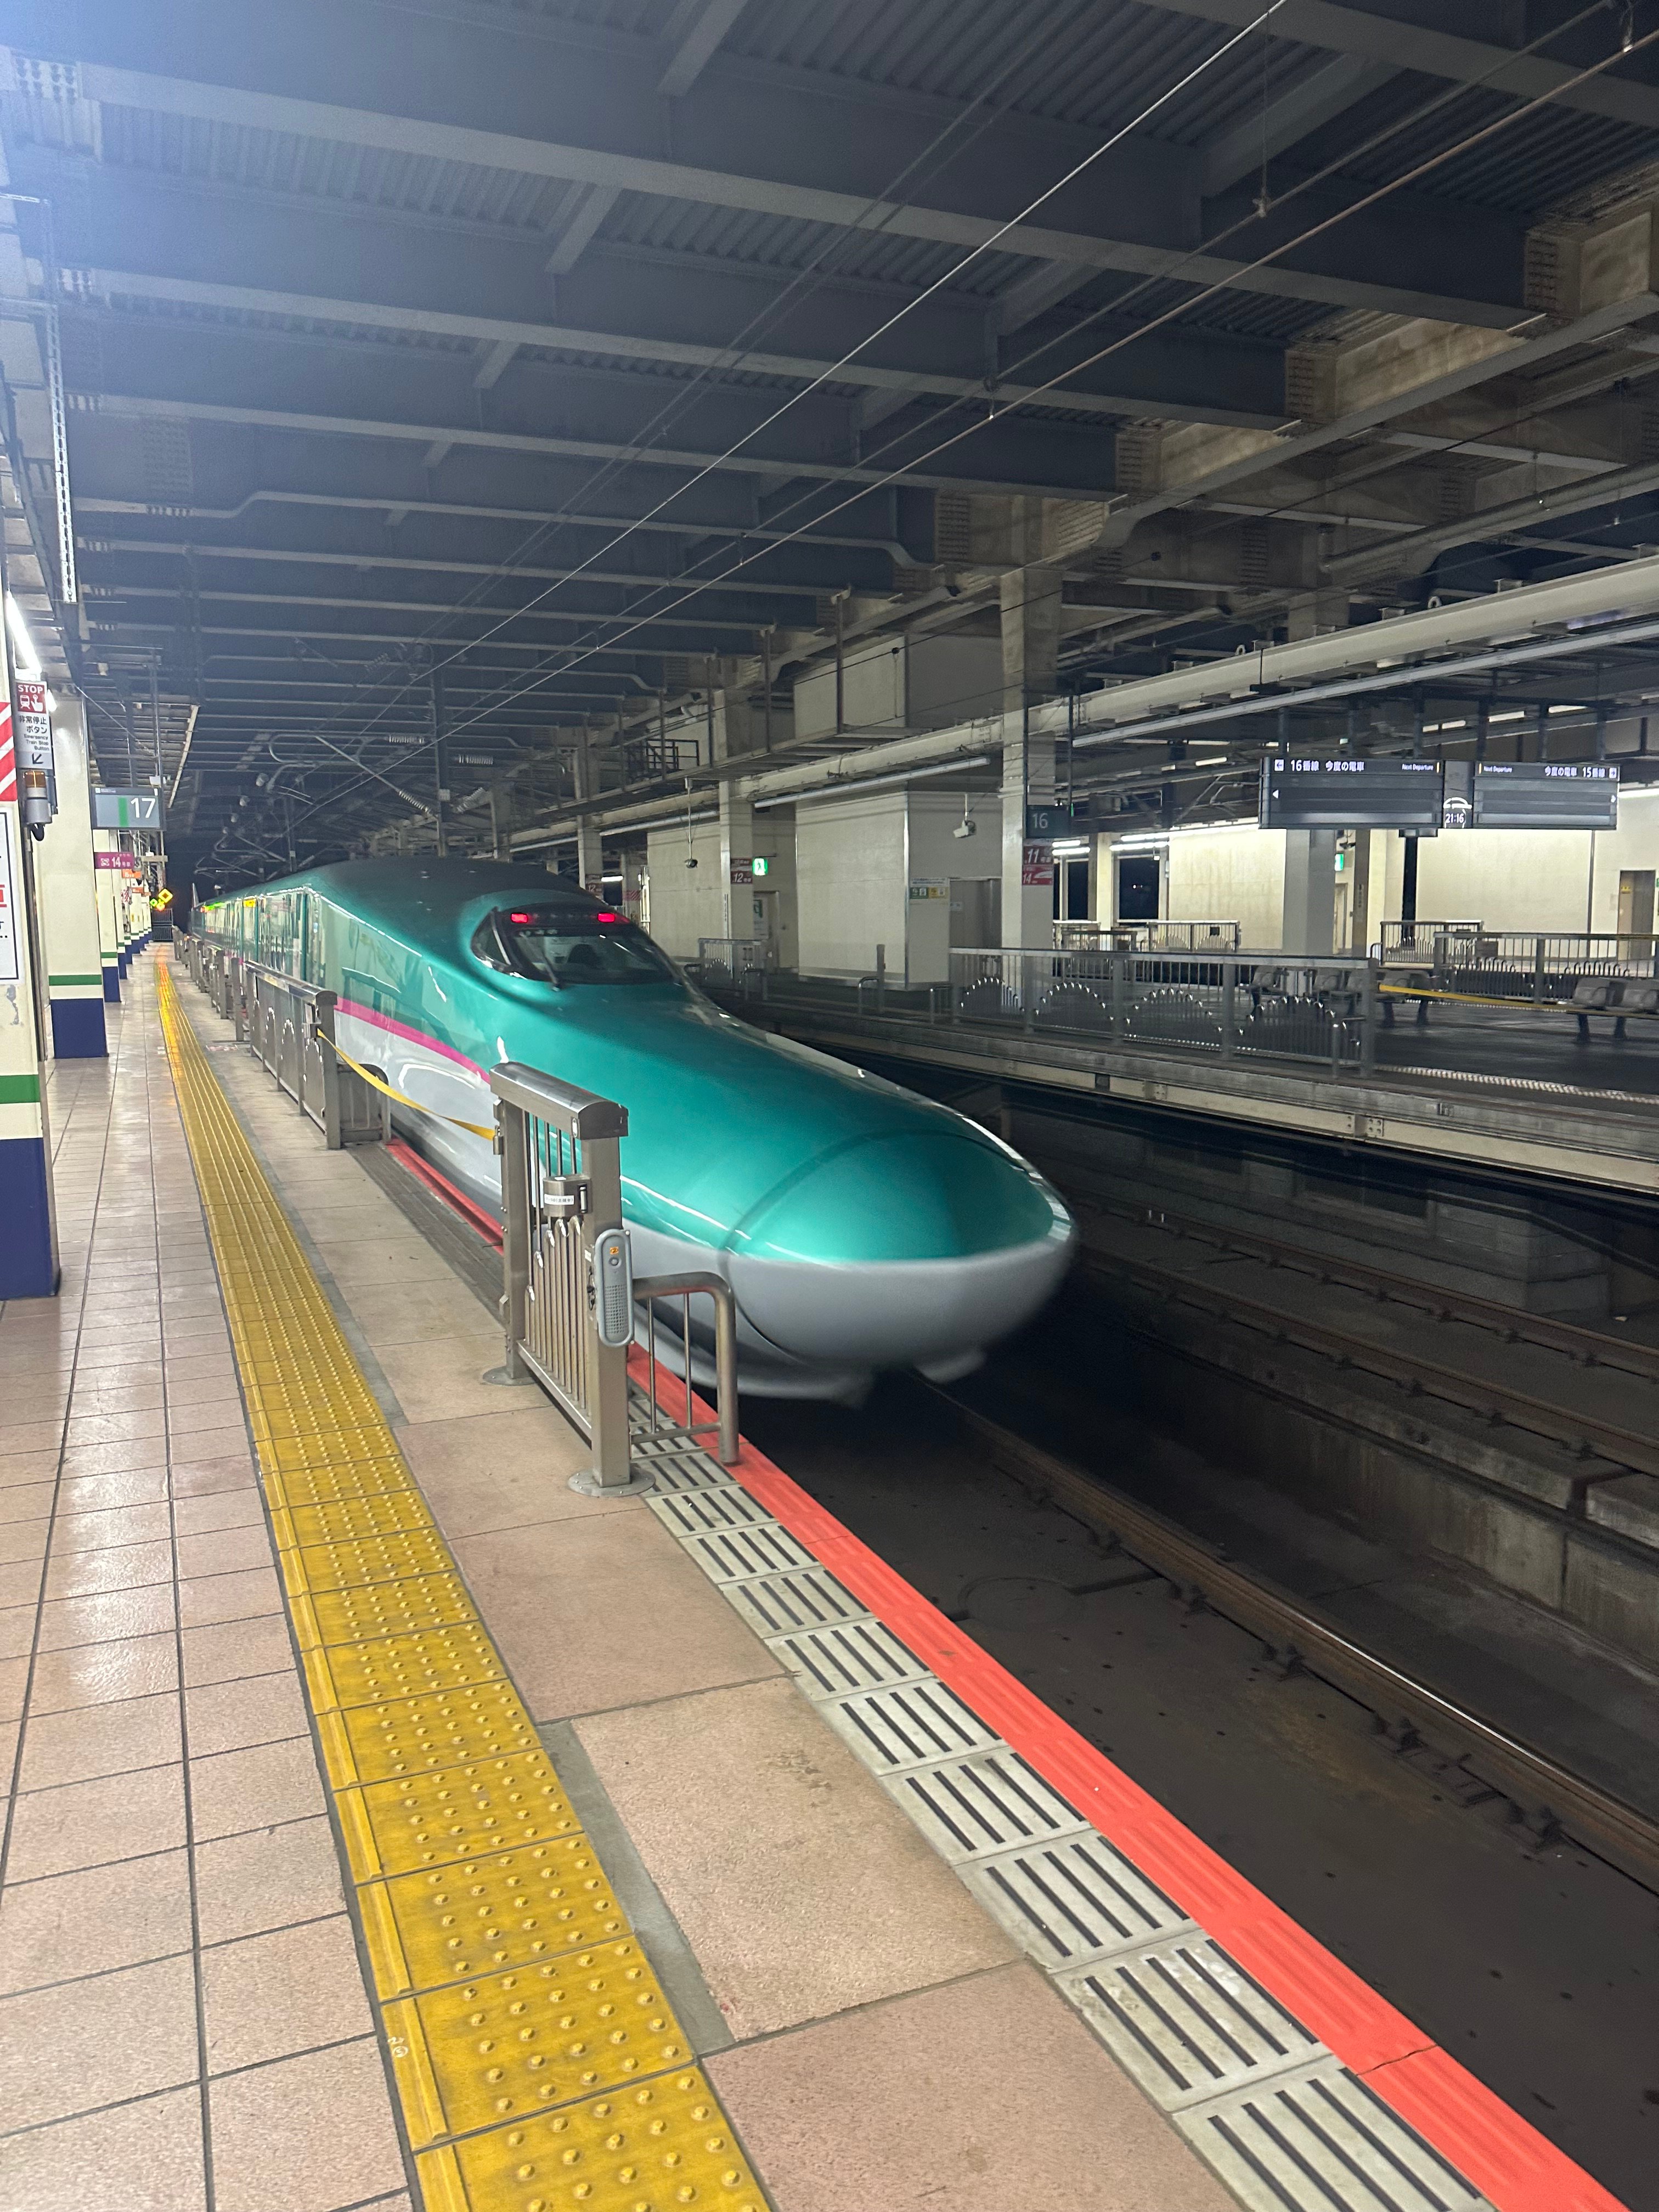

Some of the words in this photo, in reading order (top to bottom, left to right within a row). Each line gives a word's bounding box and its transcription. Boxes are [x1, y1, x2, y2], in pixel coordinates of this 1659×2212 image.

[18, 685, 43, 693] STOP
[19, 715, 47, 724] 非常停止
[26, 725, 47, 734] ボタン
[1290, 759, 1319, 771] 16番線
[131, 798, 156, 818] 17
[1032, 812, 1048, 829] 16
[1445, 813, 1464, 823] 21:16
